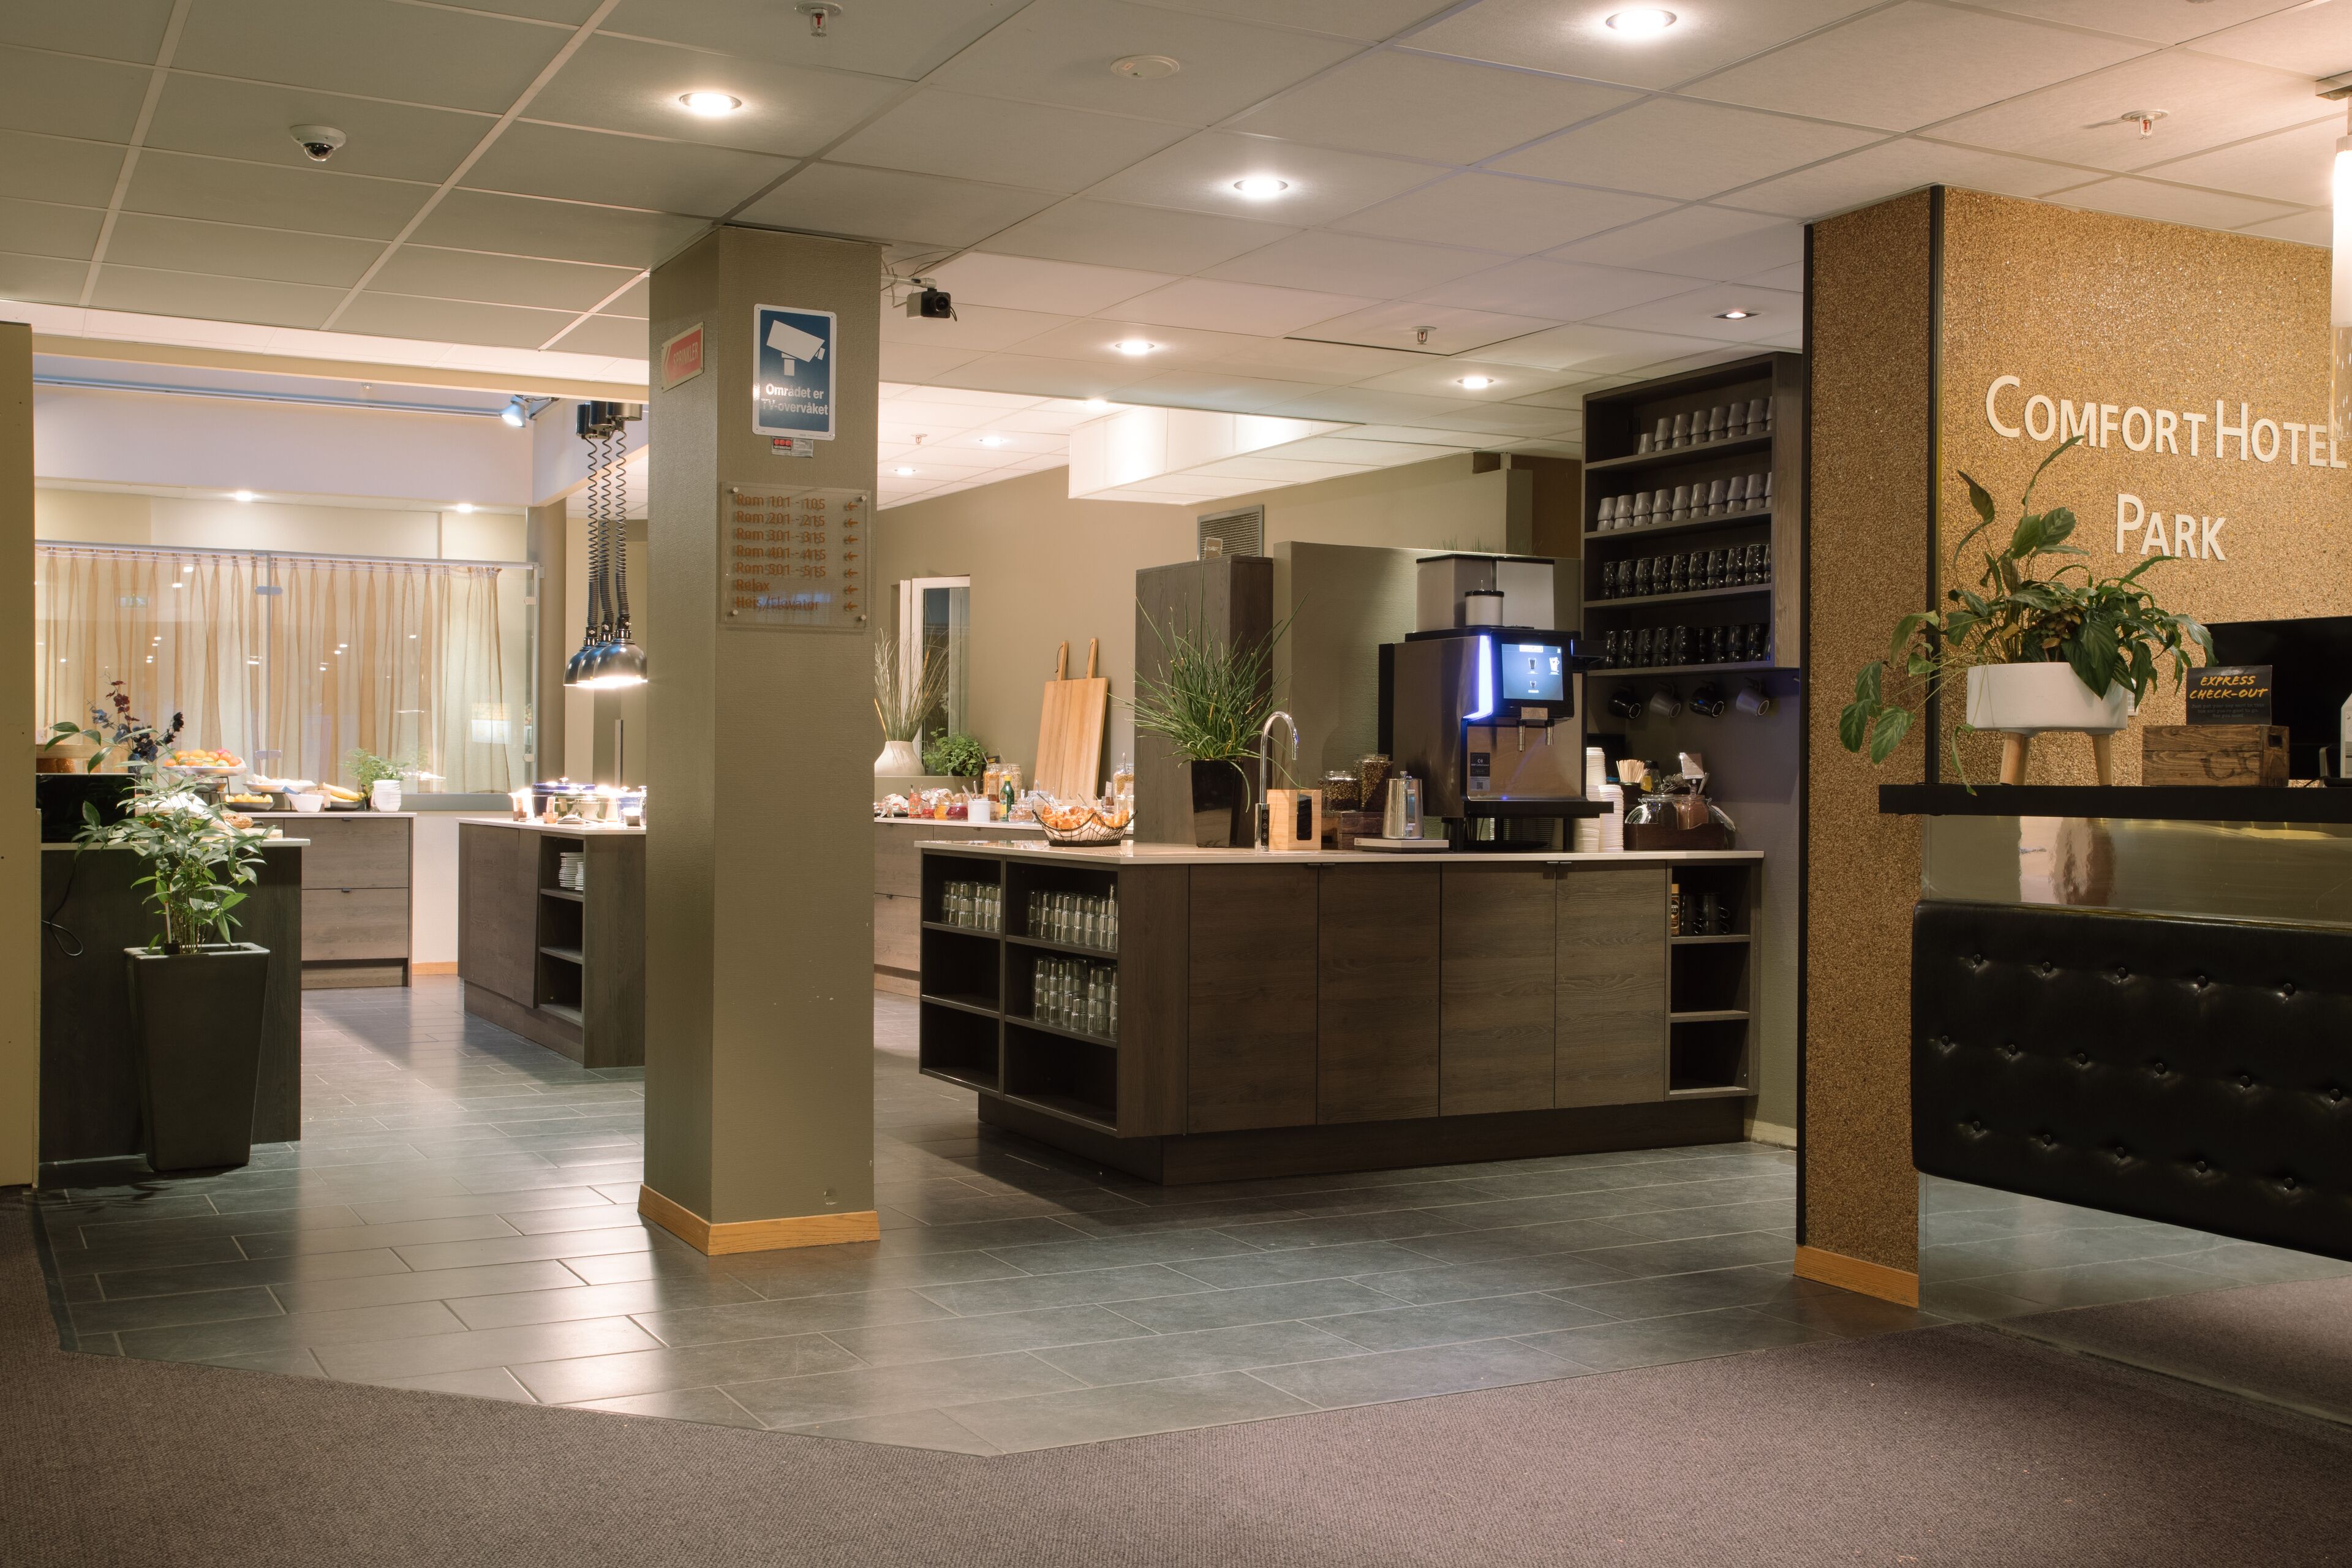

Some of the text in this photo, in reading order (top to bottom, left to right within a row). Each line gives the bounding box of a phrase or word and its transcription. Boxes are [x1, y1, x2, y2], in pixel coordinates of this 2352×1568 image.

[673, 342, 698, 369] SPRINKLER
[765, 383, 824, 400] Området er
[761, 398, 829, 416] TV-overvåket
[1985, 374, 2348, 469] COMFORT HOTEL
[737, 494, 764, 506] Rom
[770, 496, 791, 507] 101
[804, 498, 826, 510] 105
[737, 511, 764, 523] Rom
[769, 512, 790, 524] 201
[803, 514, 825, 527] 215
[737, 528, 764, 540] Rom
[769, 529, 790, 541] 301
[803, 531, 826, 543] 315
[2116, 493, 2227, 562] PARK
[737, 545, 764, 557] Rom
[769, 546, 790, 558] 401
[803, 548, 826, 560] 415
[736, 562, 764, 574] Rom
[769, 564, 790, 575] 501
[803, 565, 826, 577] 515
[736, 578, 770, 592] Relax
[2200, 676, 2256, 686] EXPRESS
[2189, 688, 2268, 699] CHECK-OUT
